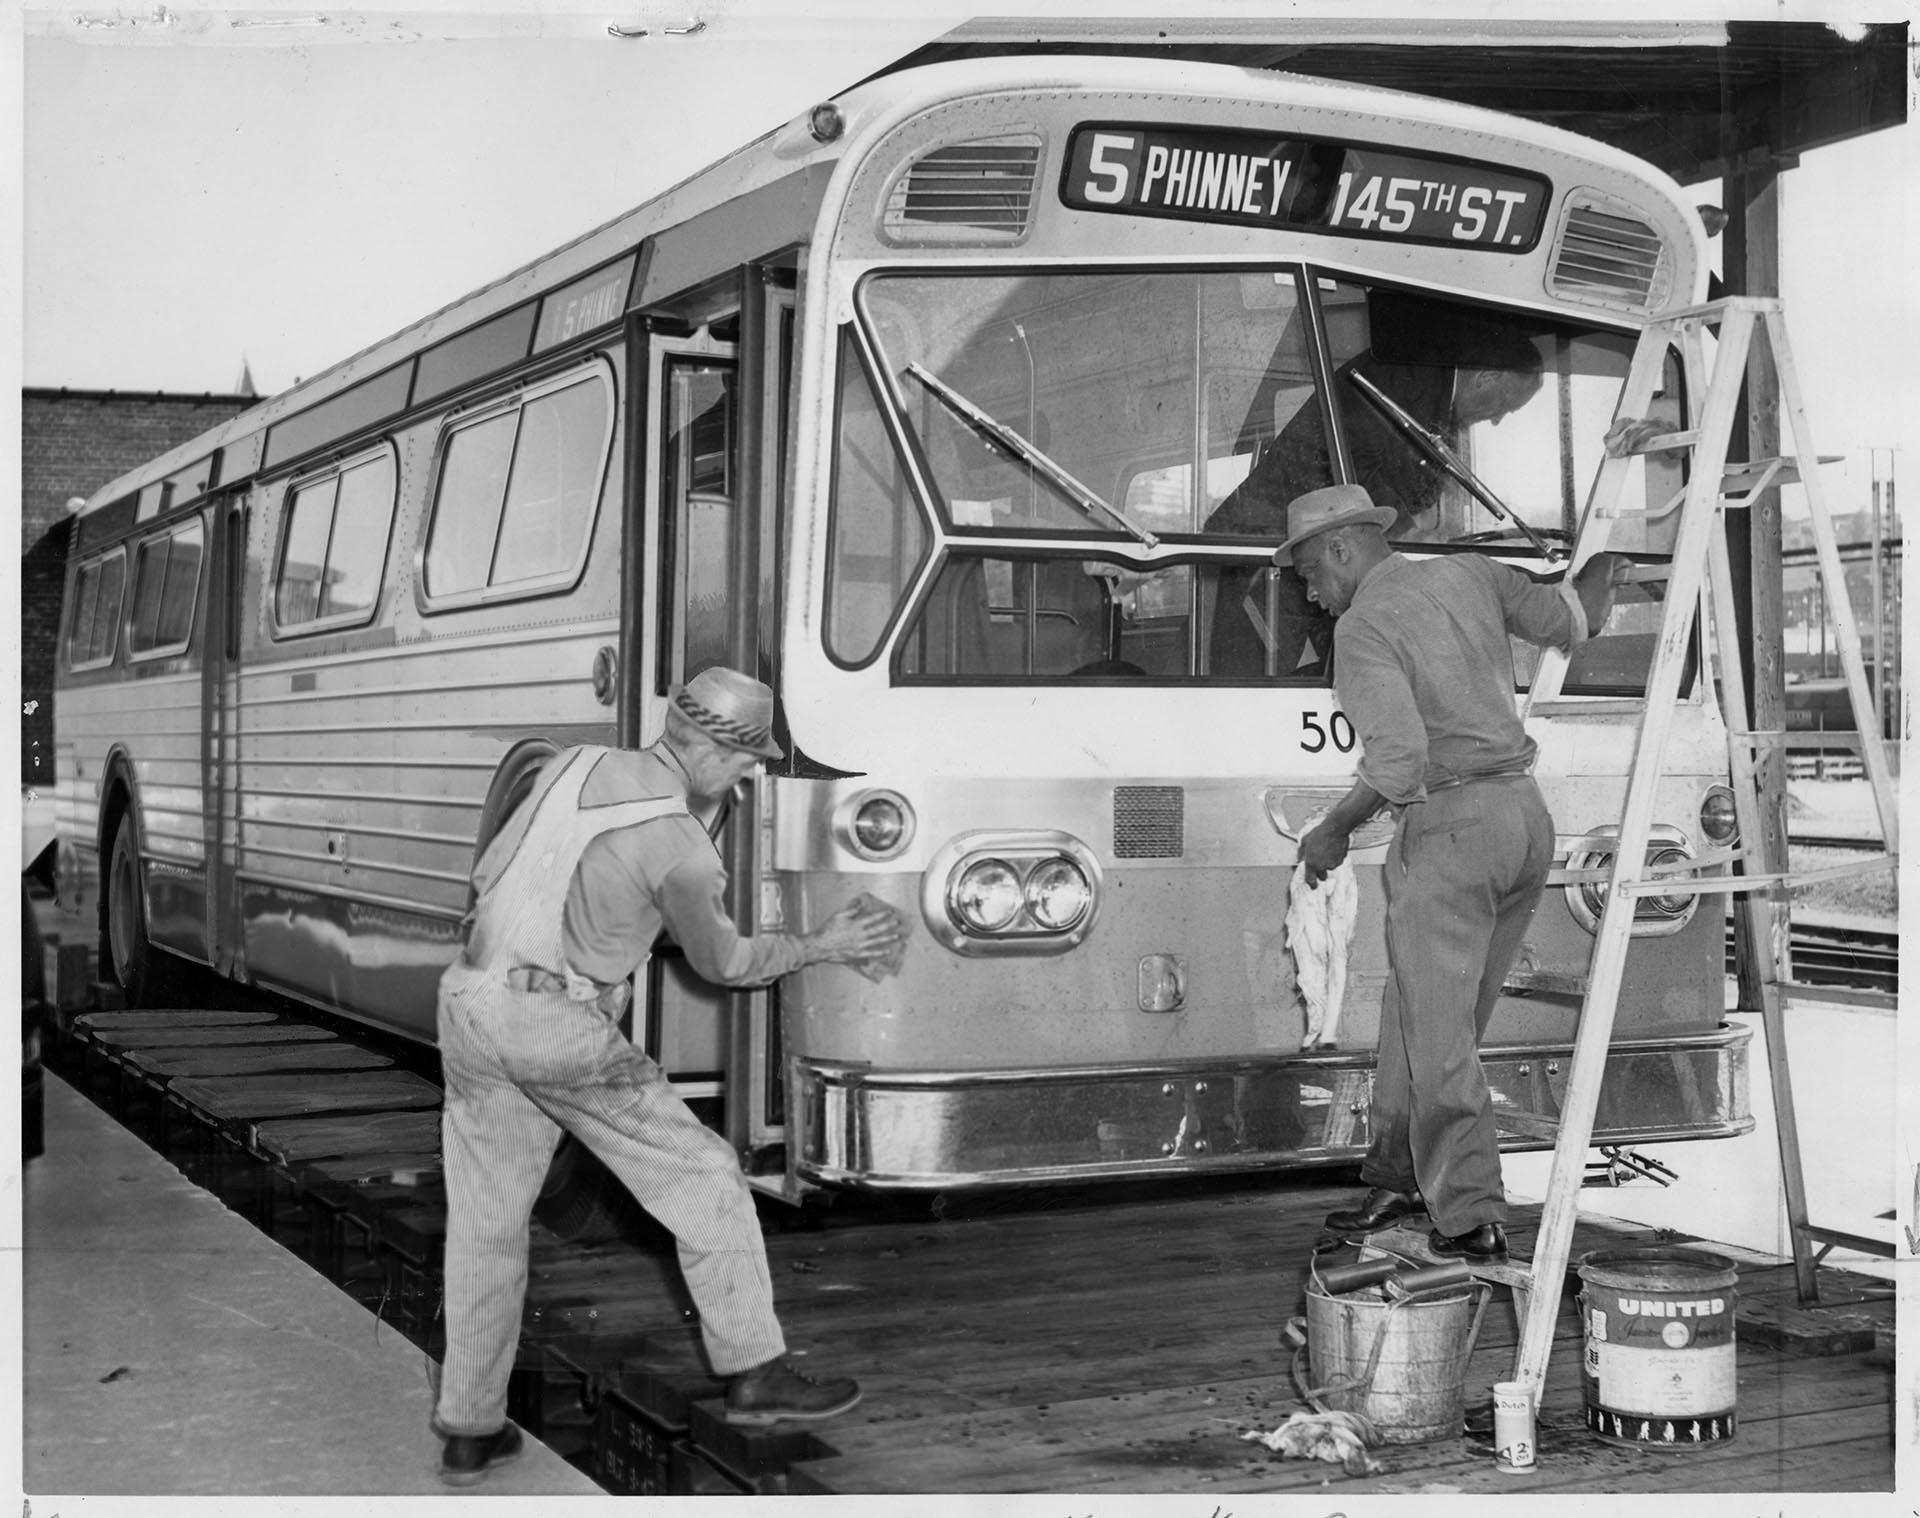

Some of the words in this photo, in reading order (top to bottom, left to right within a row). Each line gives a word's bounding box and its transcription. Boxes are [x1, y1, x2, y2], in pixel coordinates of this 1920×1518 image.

[1084, 132, 1135, 205] 5
[1140, 145, 1293, 216] PHINNEY
[1329, 172, 1458, 233] 145TH
[1451, 186, 1527, 245] ST.
[1618, 1298, 1725, 1318] UNITED
